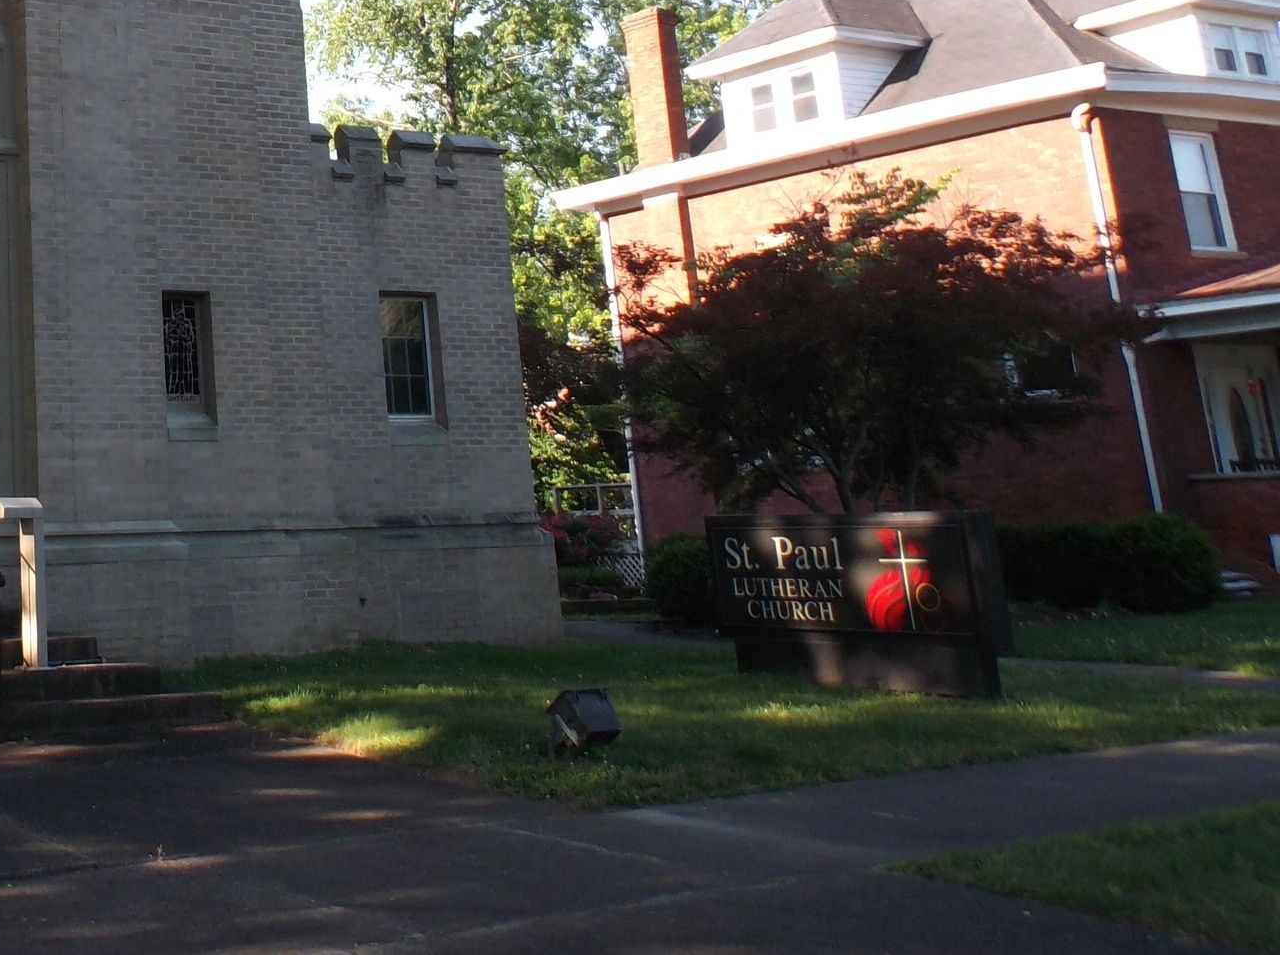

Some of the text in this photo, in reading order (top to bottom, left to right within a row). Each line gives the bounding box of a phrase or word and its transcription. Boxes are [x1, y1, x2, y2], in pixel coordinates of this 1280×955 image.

[724, 536, 844, 570] St. Paul
[733, 577, 844, 599] LUTHERAN
[747, 599, 835, 621] CHURCH
